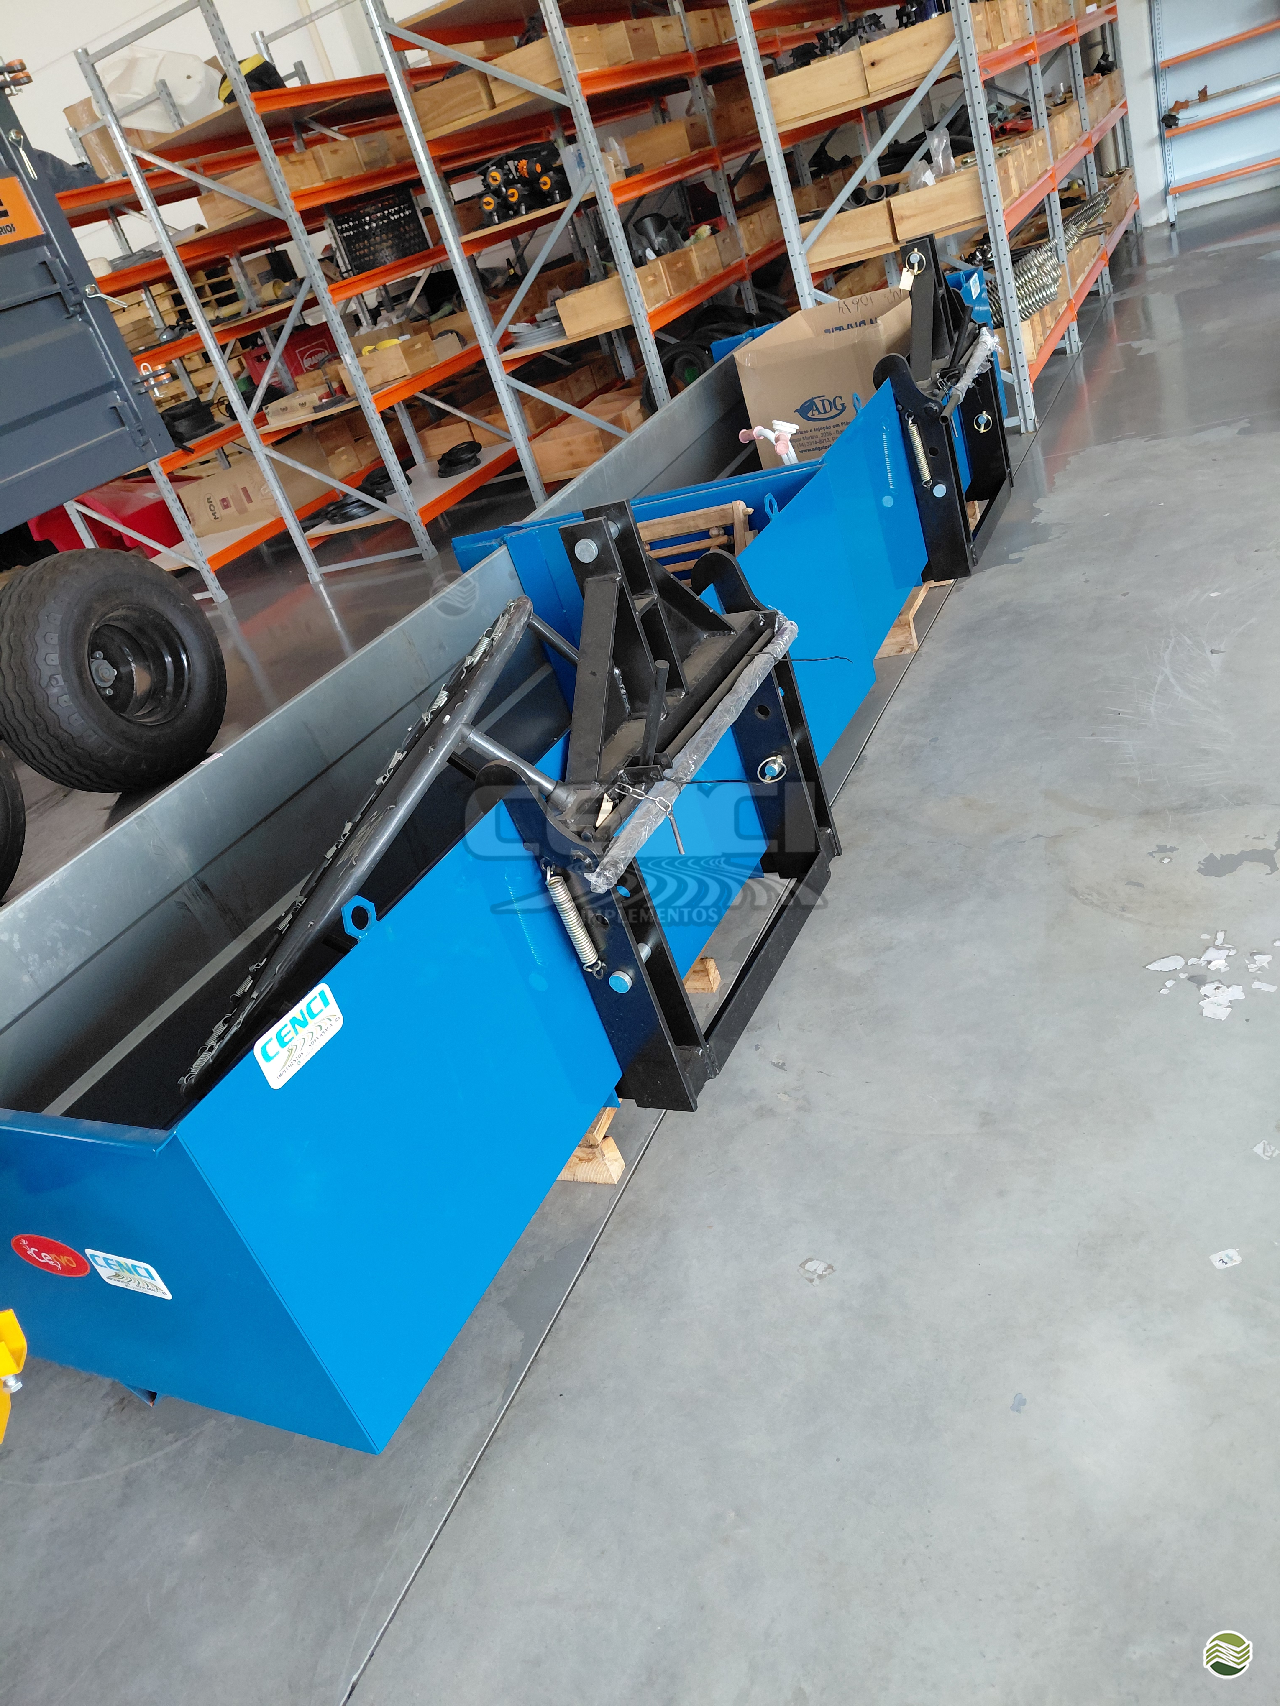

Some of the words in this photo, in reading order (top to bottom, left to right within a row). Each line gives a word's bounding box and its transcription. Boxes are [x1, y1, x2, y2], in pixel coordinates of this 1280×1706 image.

[810, 395, 846, 417] ADG
[261, 989, 330, 1063] CENCI
[89, 1253, 156, 1282] CENCI
